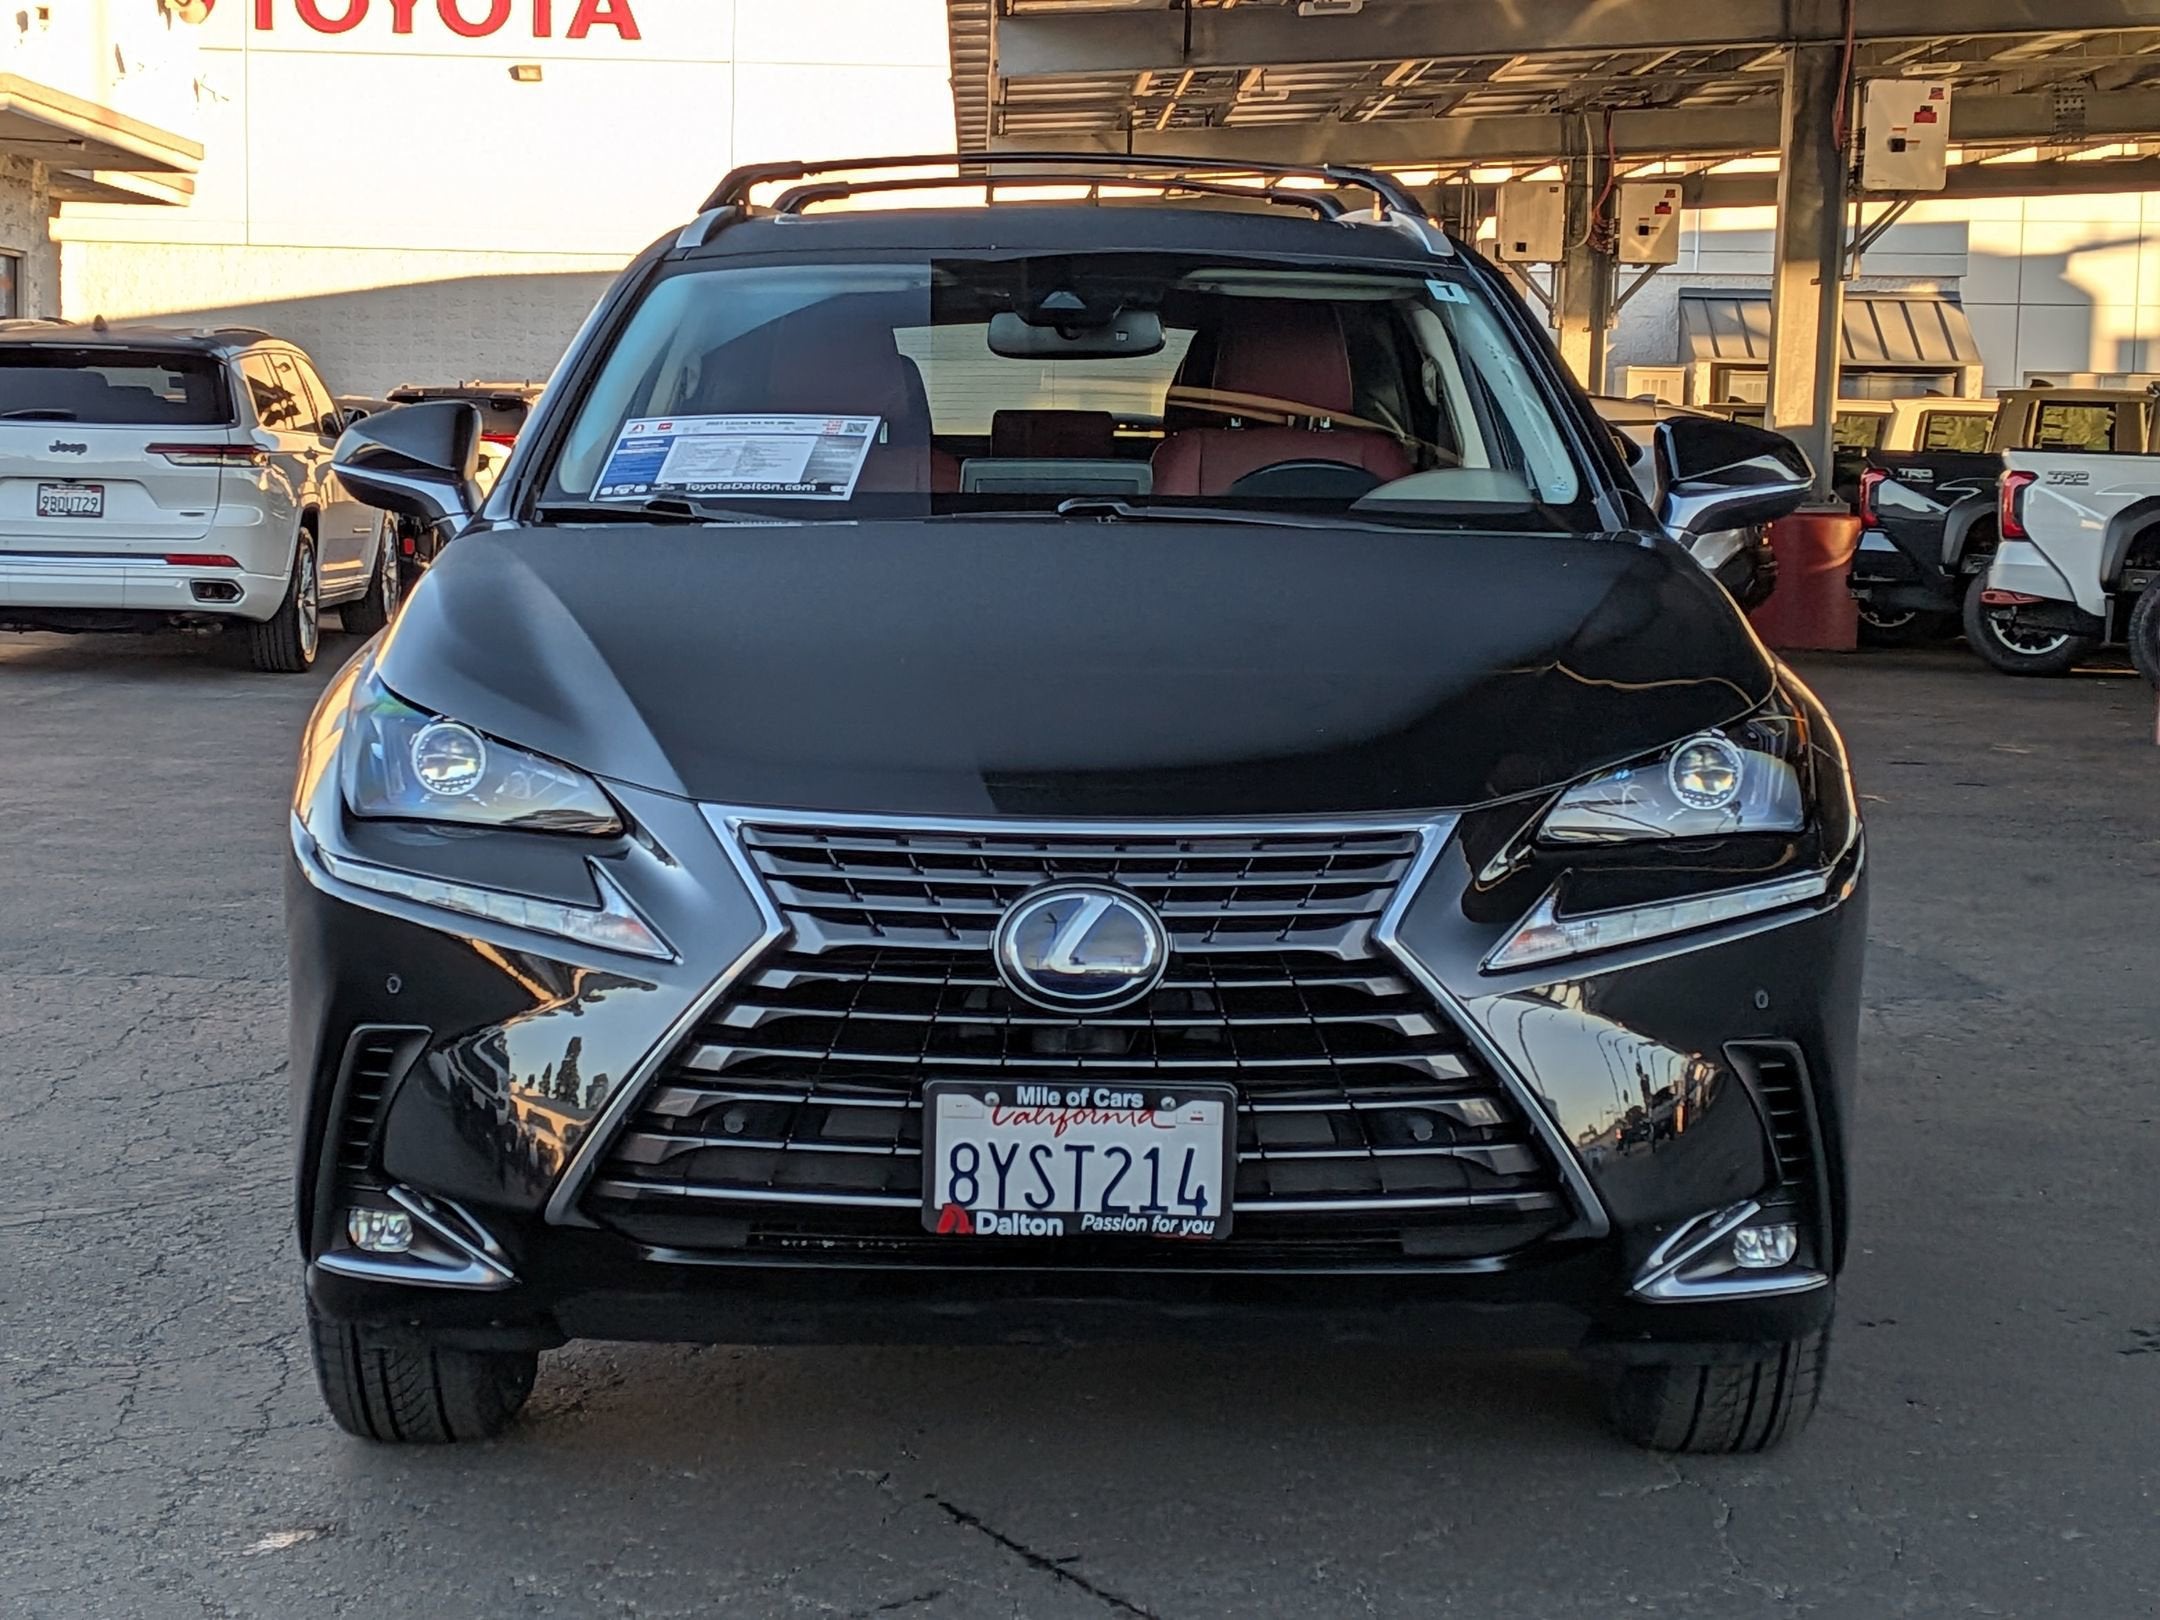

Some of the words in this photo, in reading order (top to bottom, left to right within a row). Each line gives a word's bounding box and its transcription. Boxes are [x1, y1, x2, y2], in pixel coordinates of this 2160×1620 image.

[49, 440, 87, 455] Jeep
[1898, 468, 1933, 479] TRD
[2047, 470, 2090, 482] TRD
[684, 482, 817, 492] ToyotaDalton.com
[1016, 1086, 1060, 1105] Mile
[1066, 1088, 1089, 1107] of
[1093, 1089, 1144, 1108] Cars
[991, 1105, 1176, 1138] California
[949, 1141, 1208, 1216] 8YST214
[976, 1211, 1064, 1237] Dalton
[1080, 1213, 1147, 1233] Passion
[1151, 1216, 1179, 1234] for
[1178, 1217, 1215, 1235] you
